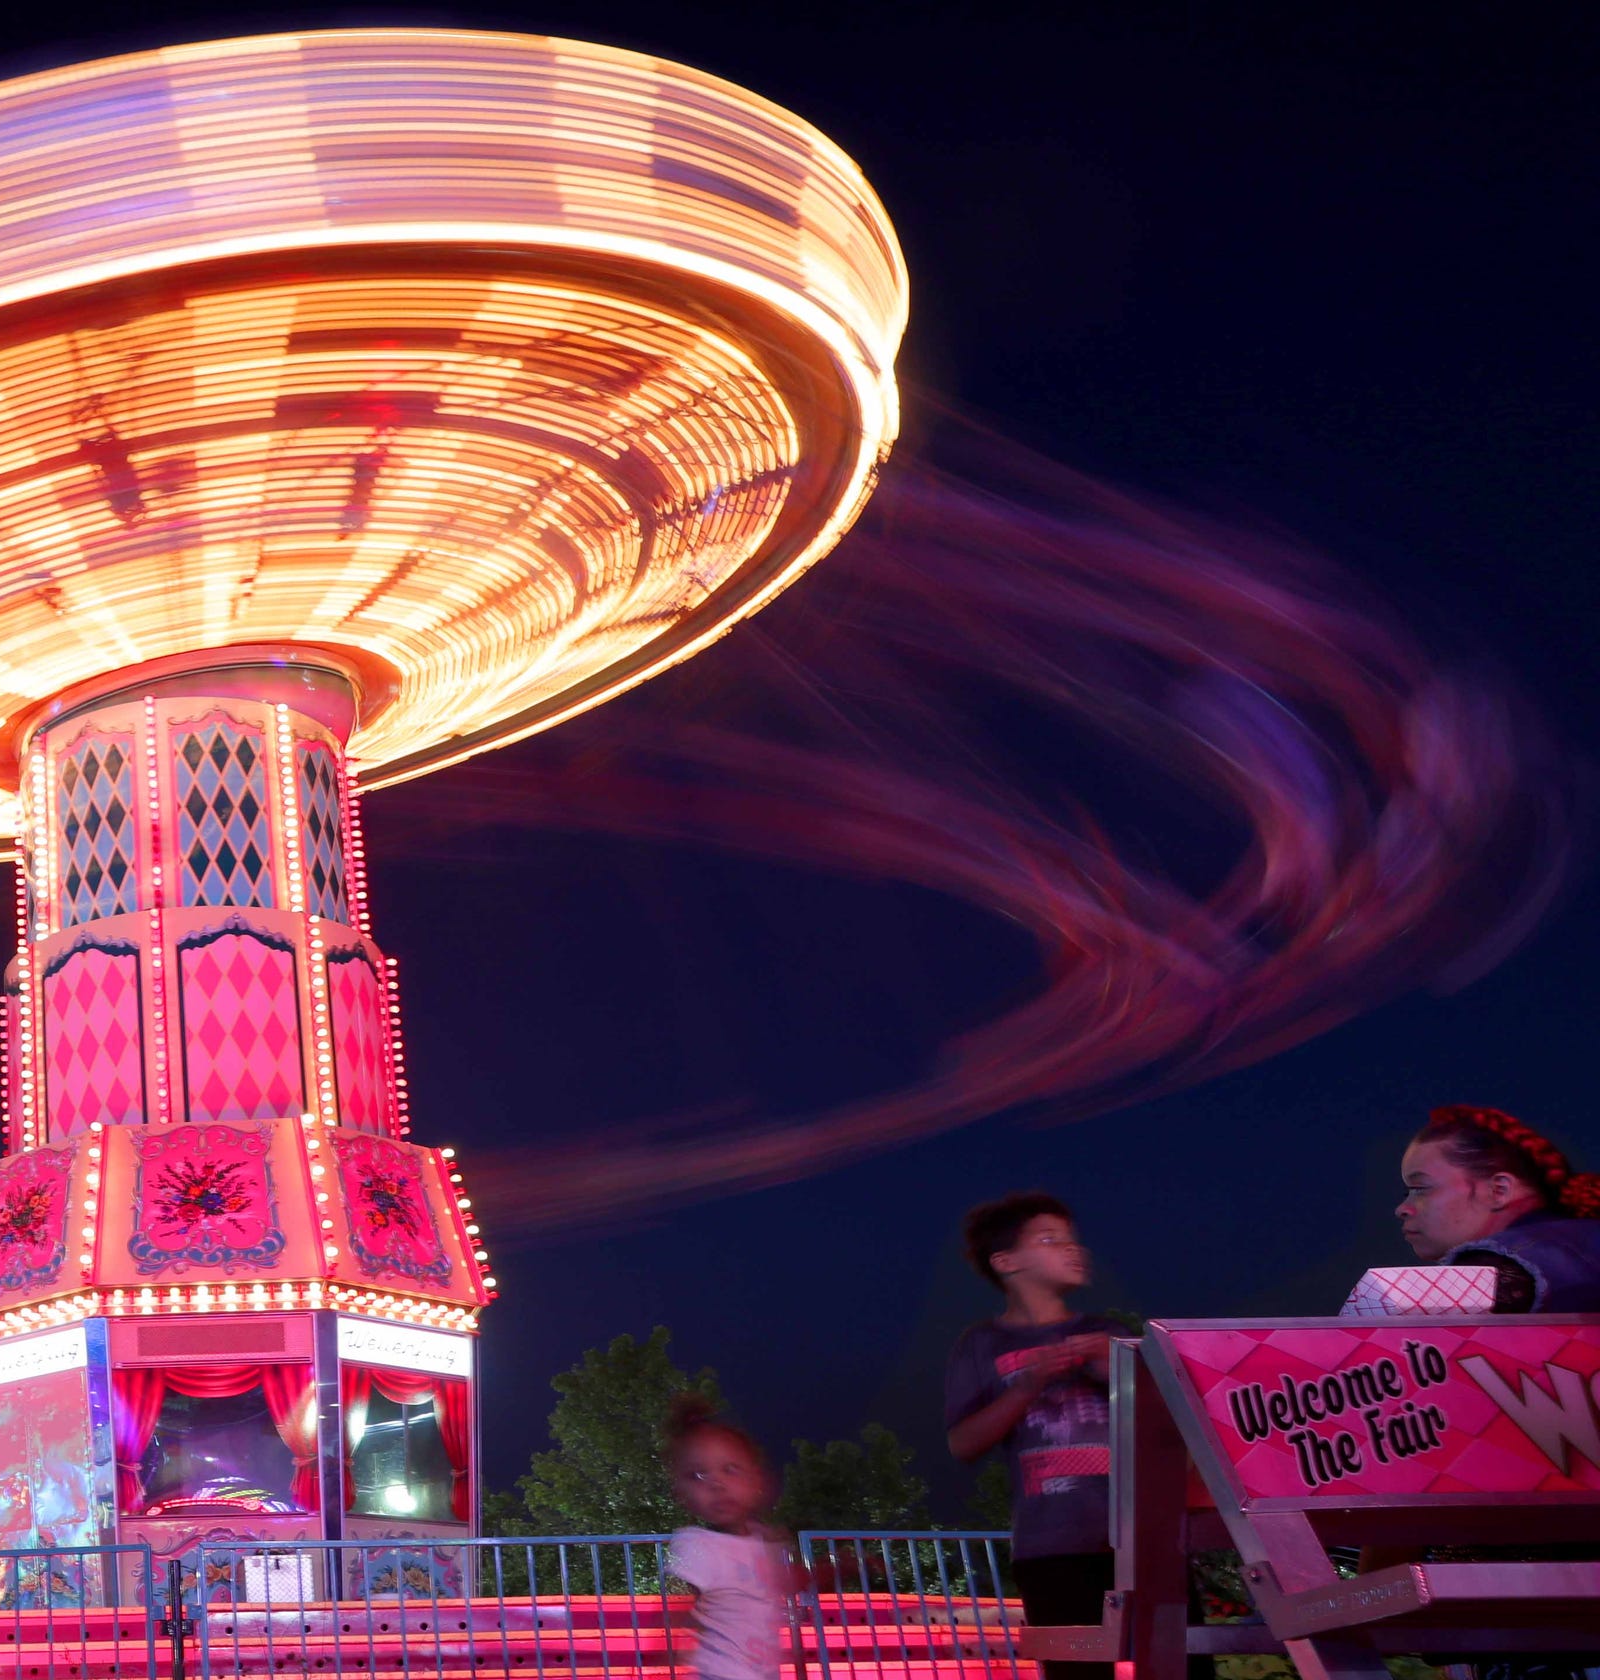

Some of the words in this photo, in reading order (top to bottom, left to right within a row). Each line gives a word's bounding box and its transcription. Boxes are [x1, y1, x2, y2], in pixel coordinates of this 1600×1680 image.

[1228, 1355, 1403, 1443] Welcome
[1403, 1339, 1447, 1389] to
[1456, 1354, 1600, 1478] W
[1286, 1427, 1363, 1488] The
[1363, 1401, 1447, 1464] Fair
